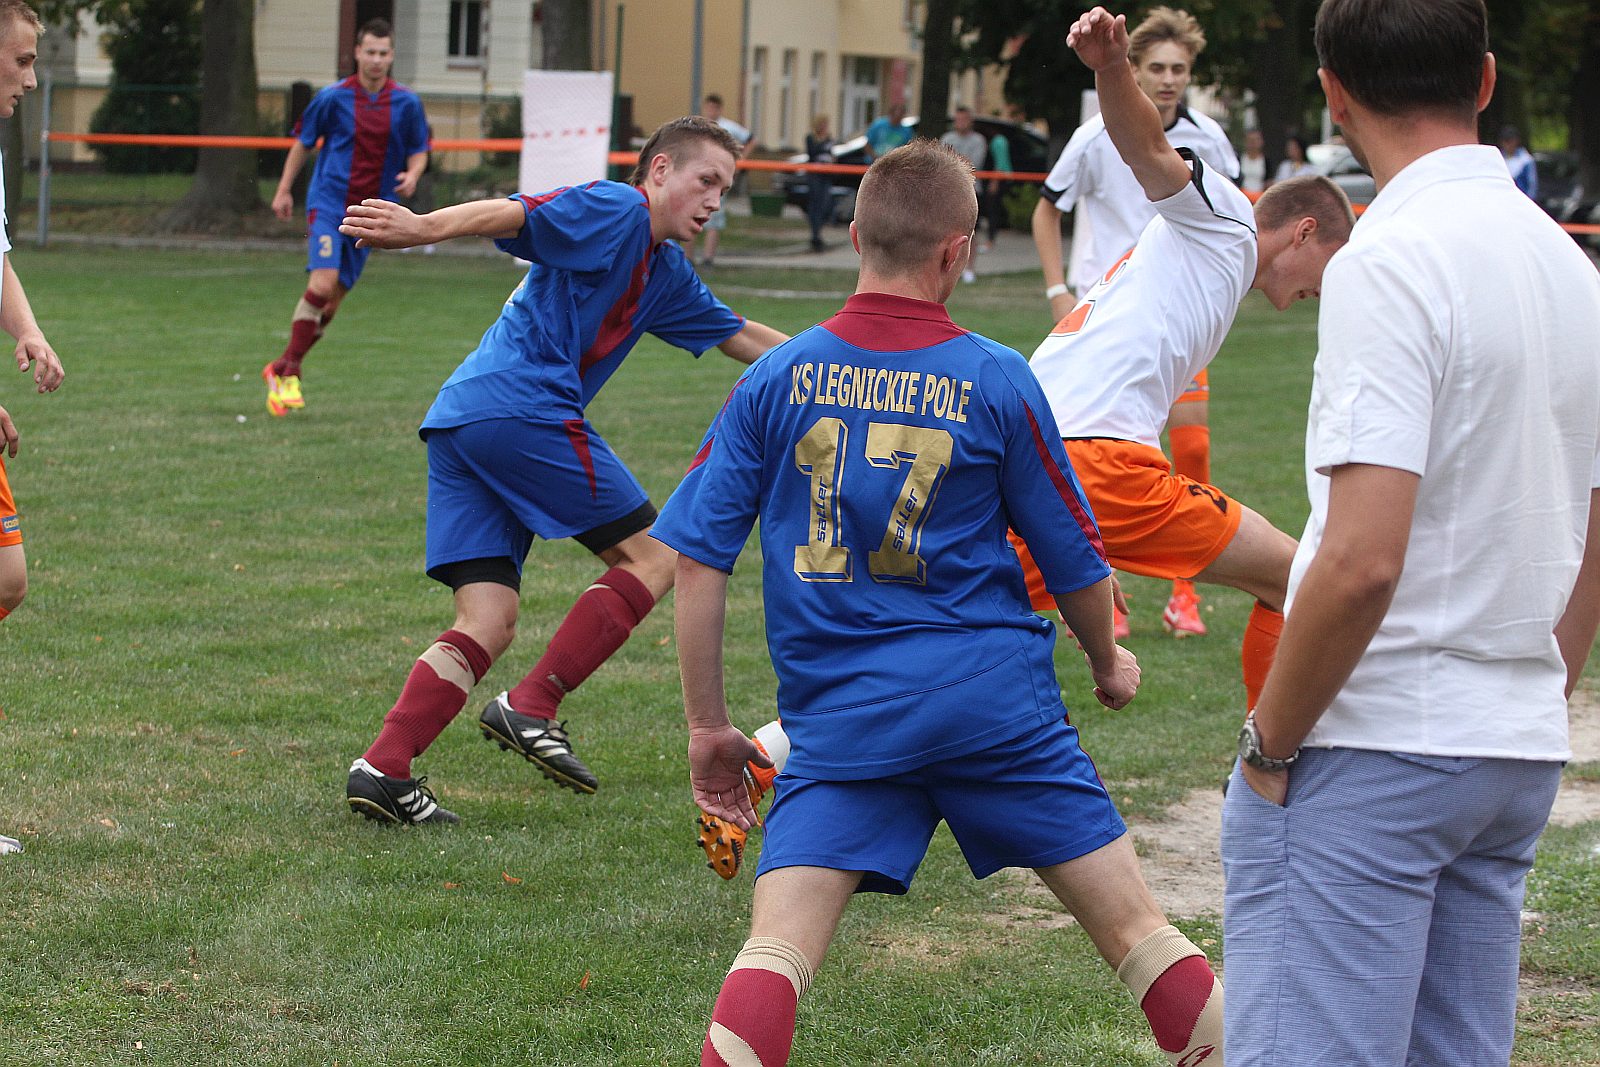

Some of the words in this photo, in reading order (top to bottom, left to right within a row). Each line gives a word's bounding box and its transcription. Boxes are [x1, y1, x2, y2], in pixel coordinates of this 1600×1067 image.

[319, 235, 332, 257] 3
[790, 362, 814, 405] KS
[815, 363, 921, 414] LEGNICKIE
[921, 374, 973, 423] POLE
[794, 417, 954, 586] 17
